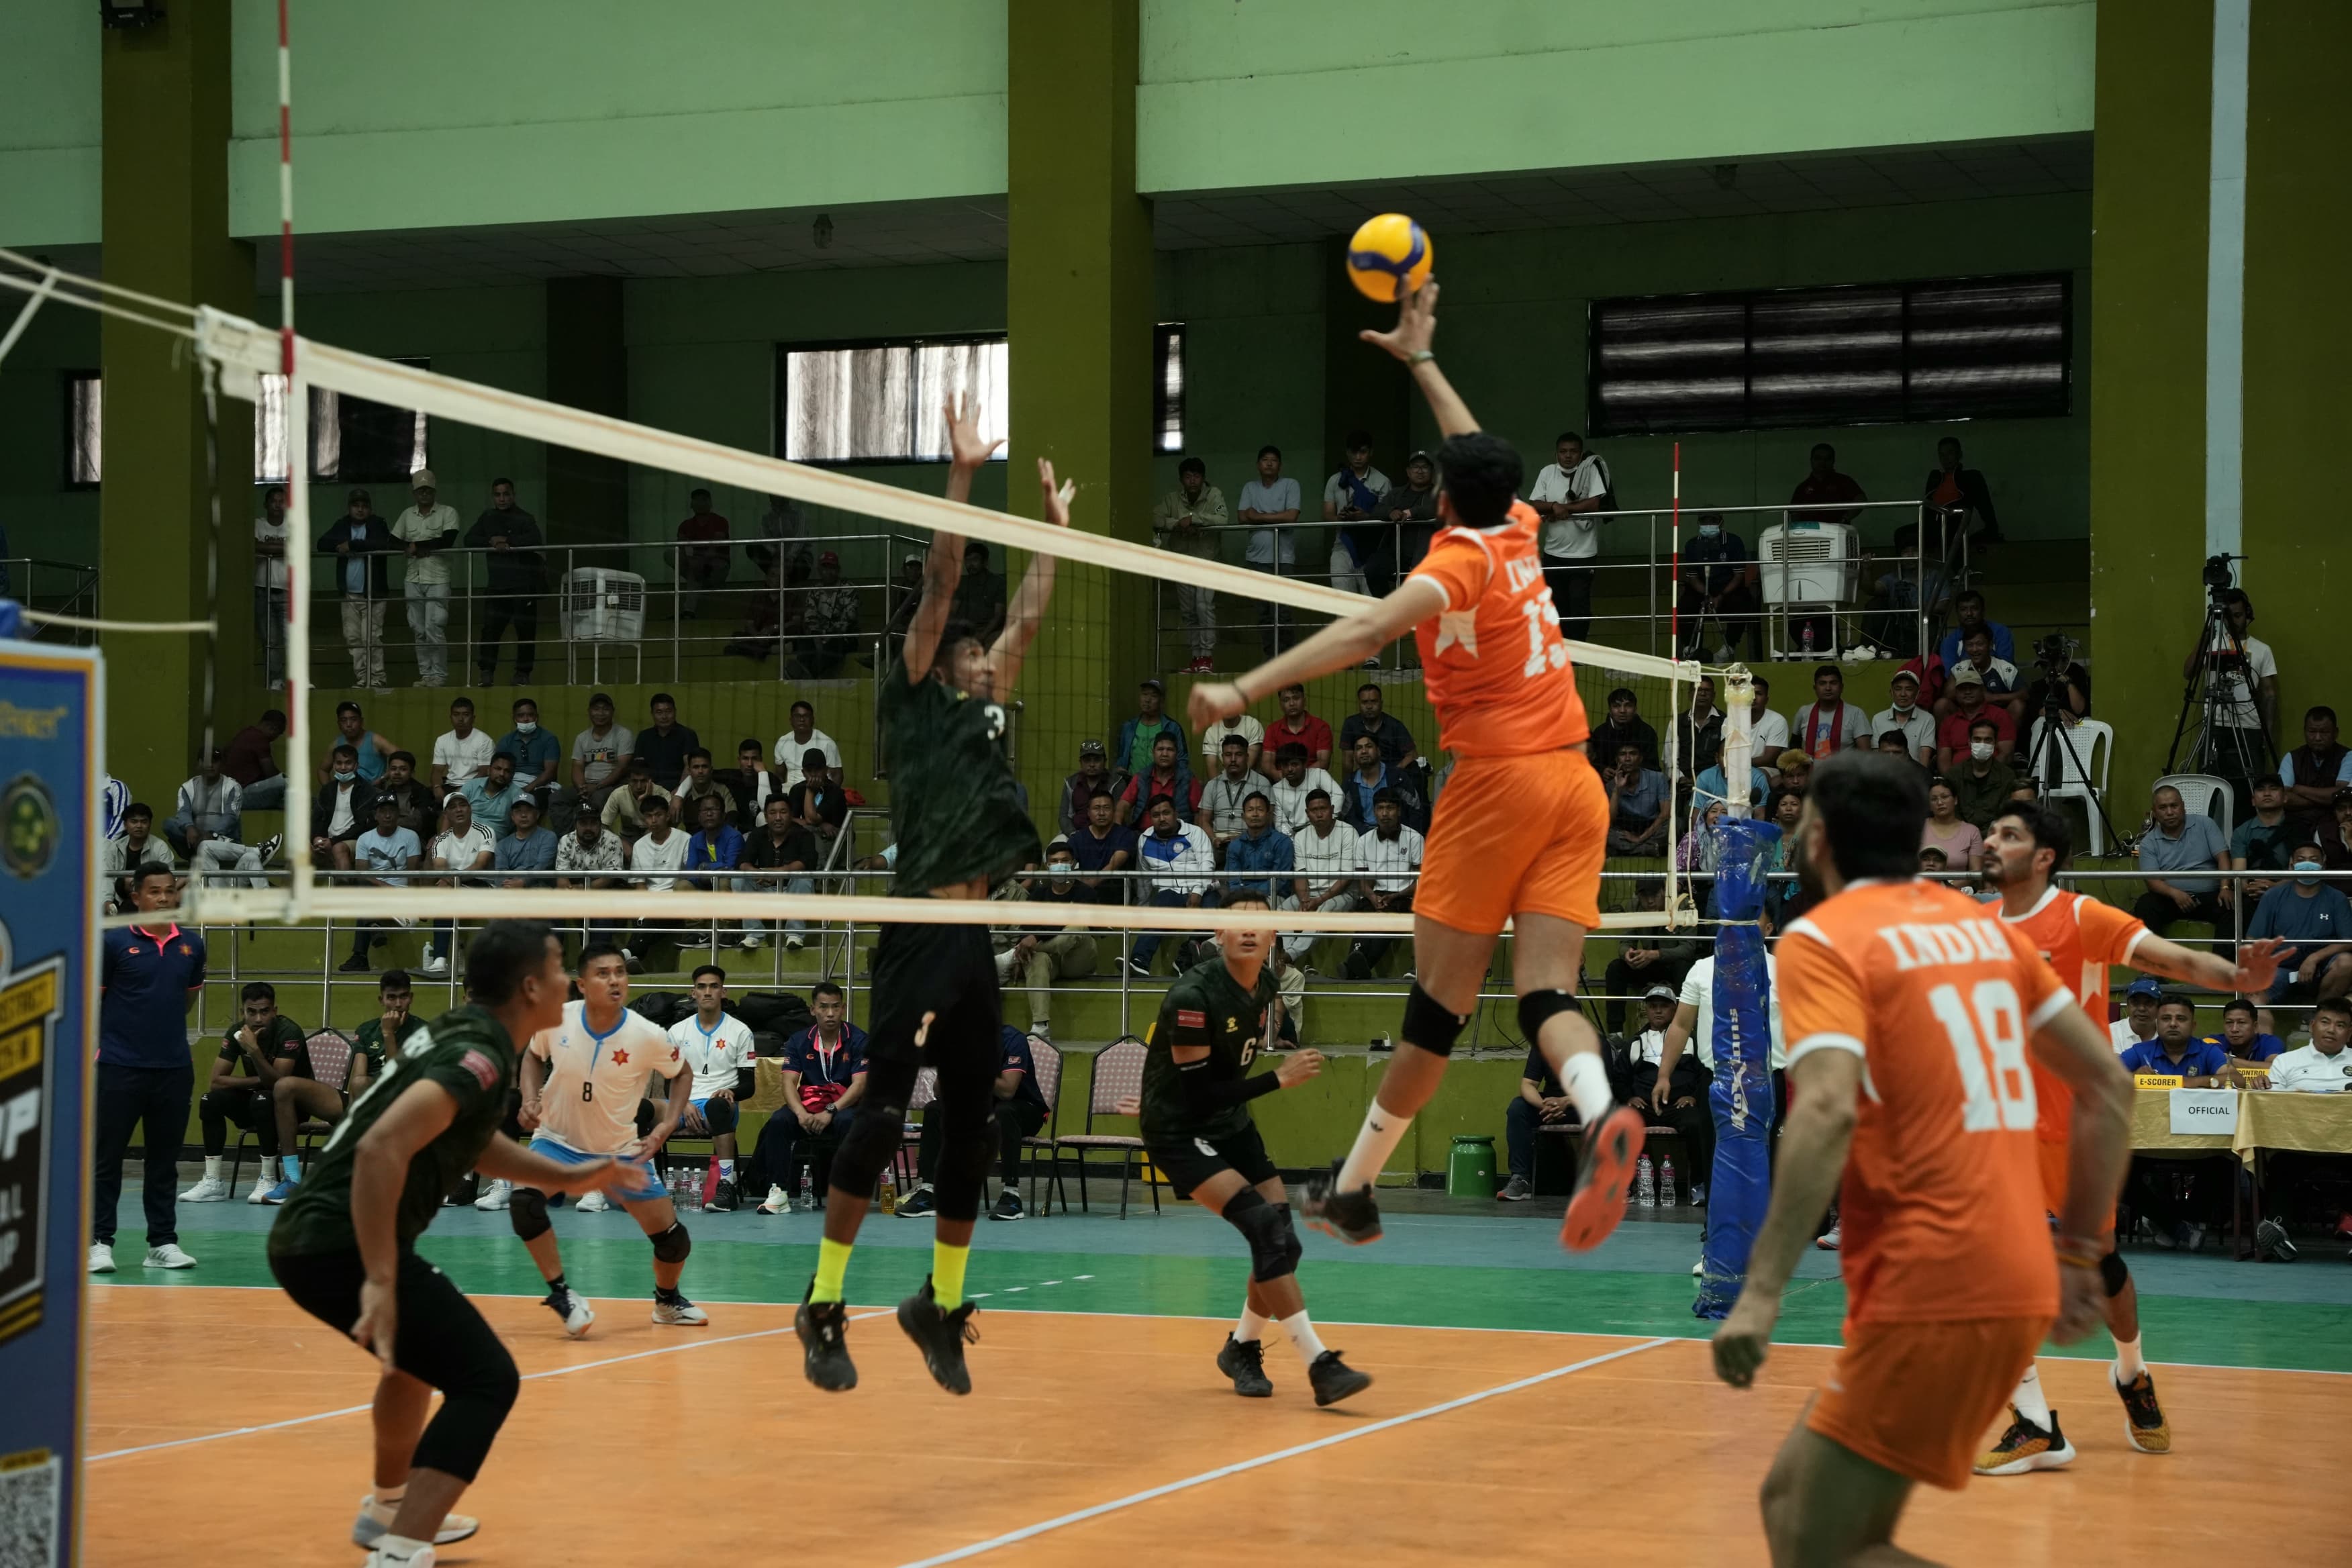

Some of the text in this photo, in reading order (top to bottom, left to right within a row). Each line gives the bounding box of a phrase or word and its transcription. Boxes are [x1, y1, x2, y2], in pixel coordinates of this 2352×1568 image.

[1877, 918, 2014, 971] INDIA
[1240, 1037, 1257, 1067] 6
[1927, 978, 2039, 1132] 18
[701, 1063, 708, 1075] 4
[582, 1081, 593, 1102] 8
[2139, 1078, 2177, 1087] E-SCORER
[2188, 1106, 2231, 1115] OFFICIAL
